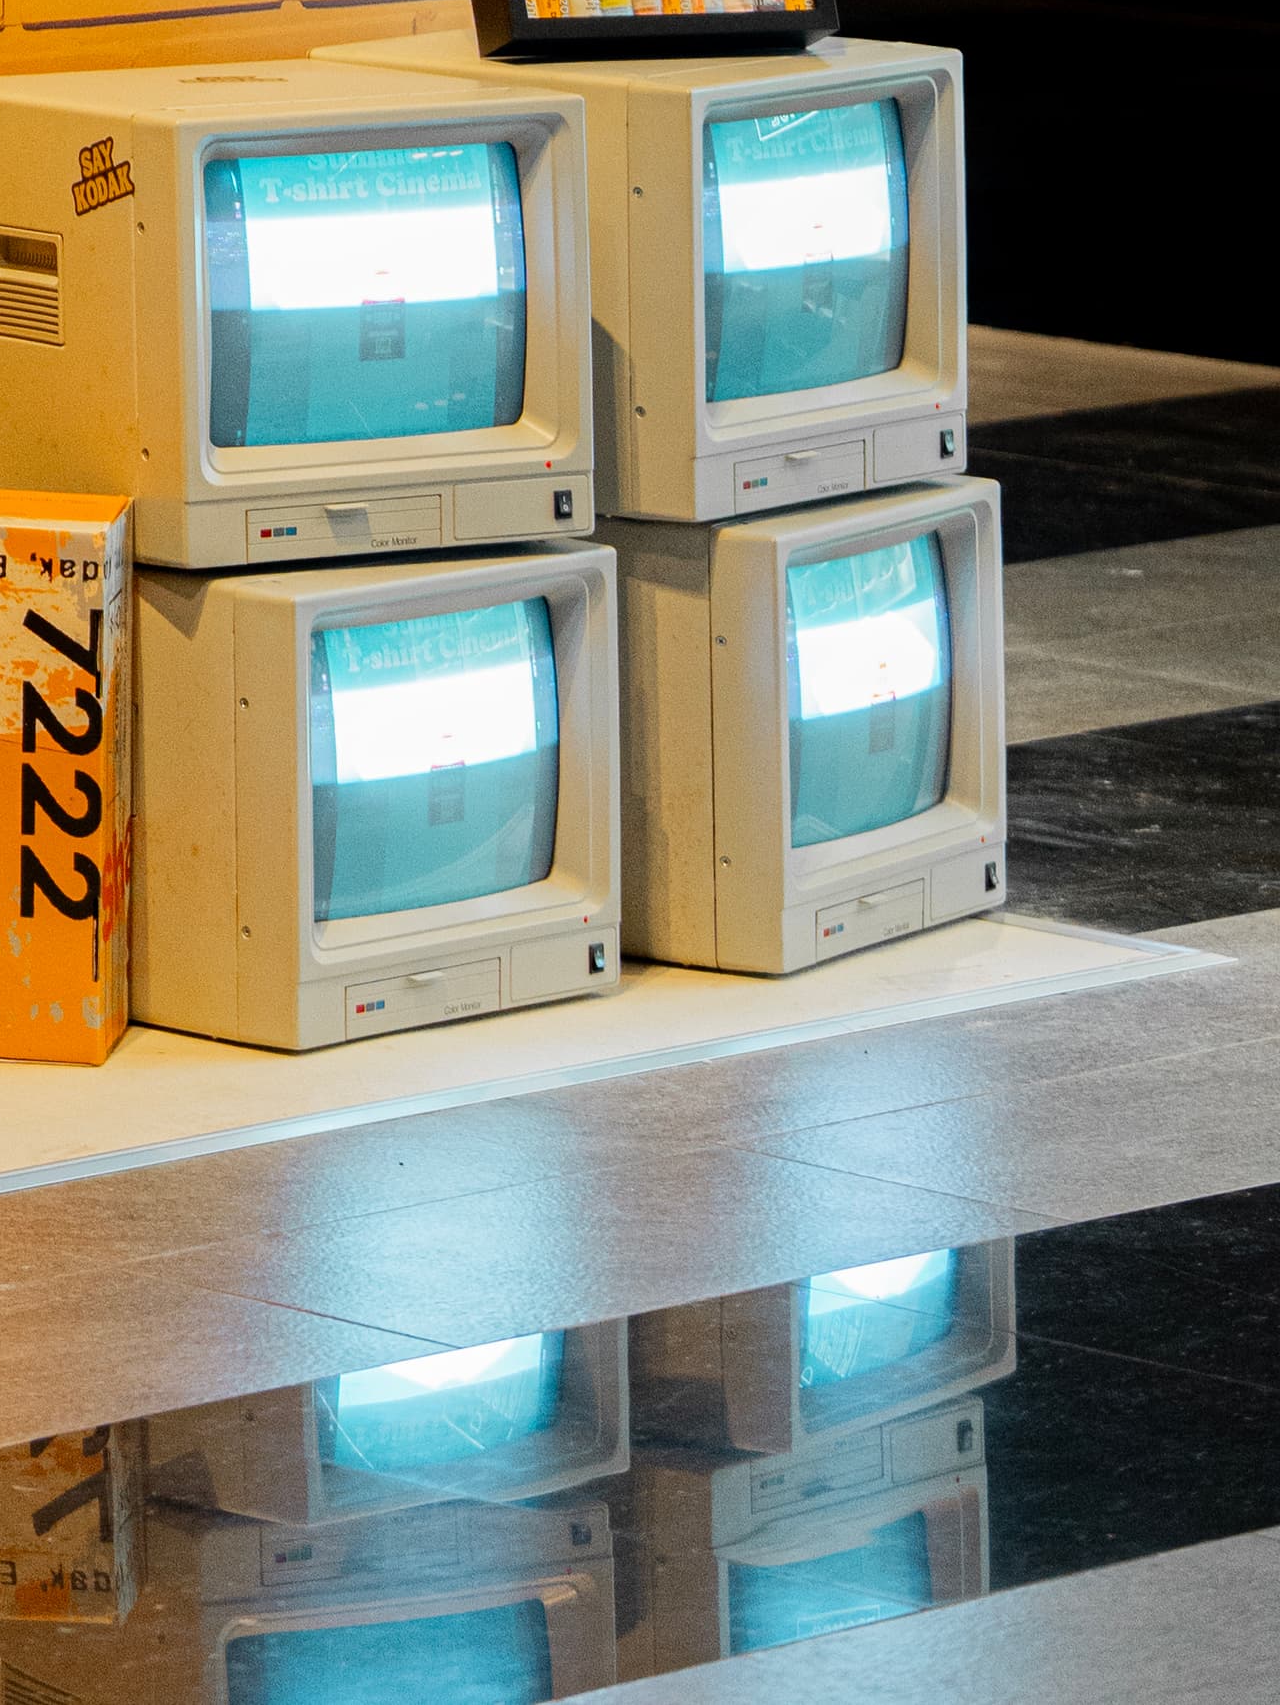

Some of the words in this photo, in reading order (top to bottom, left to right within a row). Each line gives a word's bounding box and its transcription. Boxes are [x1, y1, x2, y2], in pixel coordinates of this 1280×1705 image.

[79, 136, 114, 179] SAY
[72, 161, 135, 216] KODAK
[259, 174, 369, 204] T-shirt
[376, 169, 483, 197] Cinema
[20, 609, 103, 921] 7222
